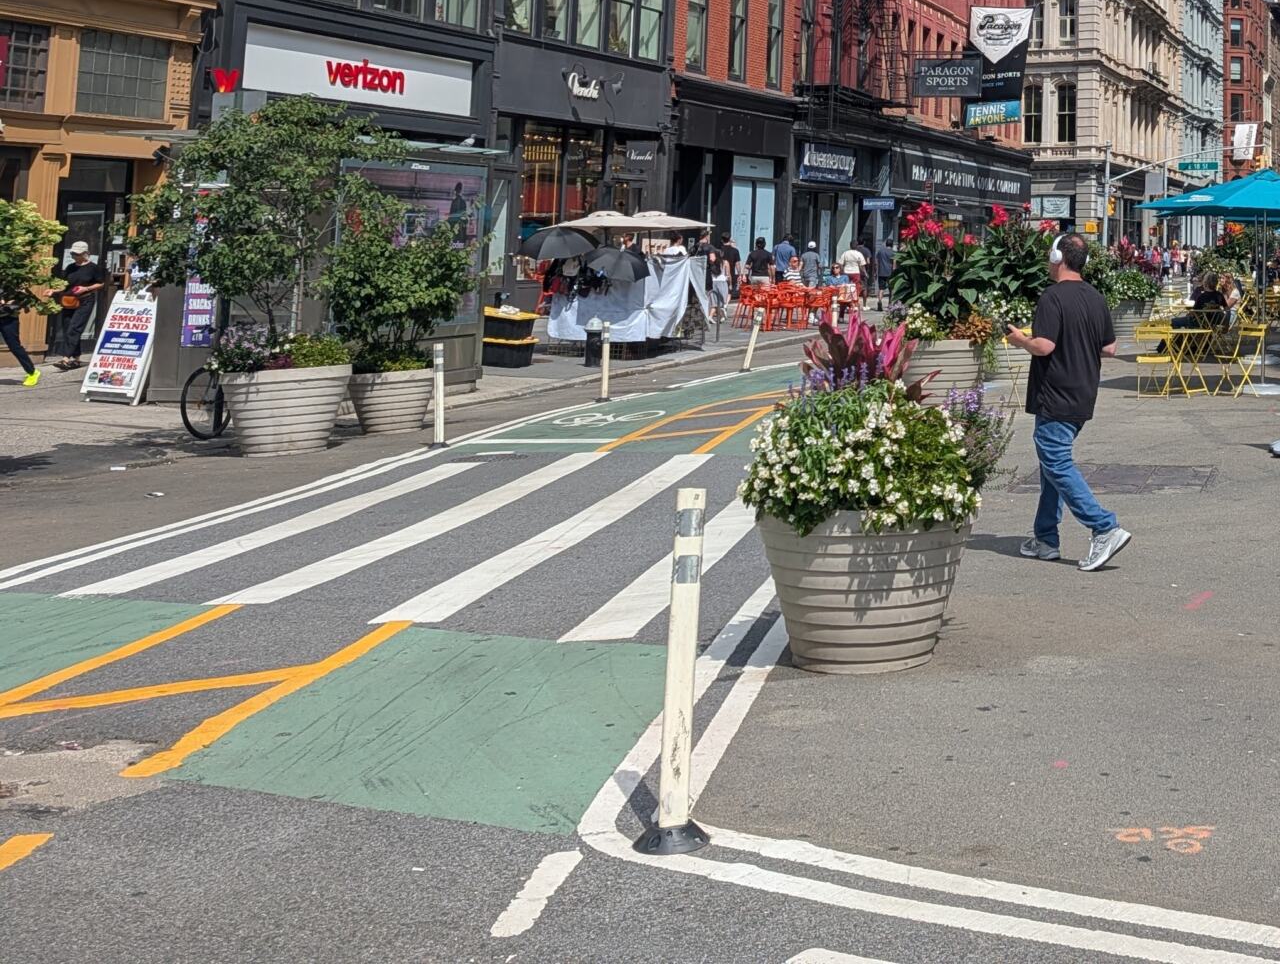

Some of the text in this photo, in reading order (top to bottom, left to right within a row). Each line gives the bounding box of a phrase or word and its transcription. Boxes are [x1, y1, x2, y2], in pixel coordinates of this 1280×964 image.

[979, 16, 1021, 33] Paragon
[920, 66, 974, 75] PARAGON
[997, 71, 1021, 79] SPORTS
[326, 59, 405, 95] verizon
[925, 77, 969, 86] SPORTS
[568, 72, 600, 98] Venchi
[969, 103, 1006, 116] TENNIS
[626, 149, 654, 161] Venchi
[912, 164, 942, 184] PARAGON
[945, 169, 975, 188] SPORTING
[996, 179, 1021, 194] COMPANY
[188, 298, 212, 310] SNACKS
[114, 307, 134, 315] 17th
[110, 315, 152, 324] SMOKE
[187, 314, 210, 326] DRINKS
[108, 322, 149, 331] STAND
[111, 356, 136, 364] SMOKE
[116, 363, 138, 371] ITEMS
